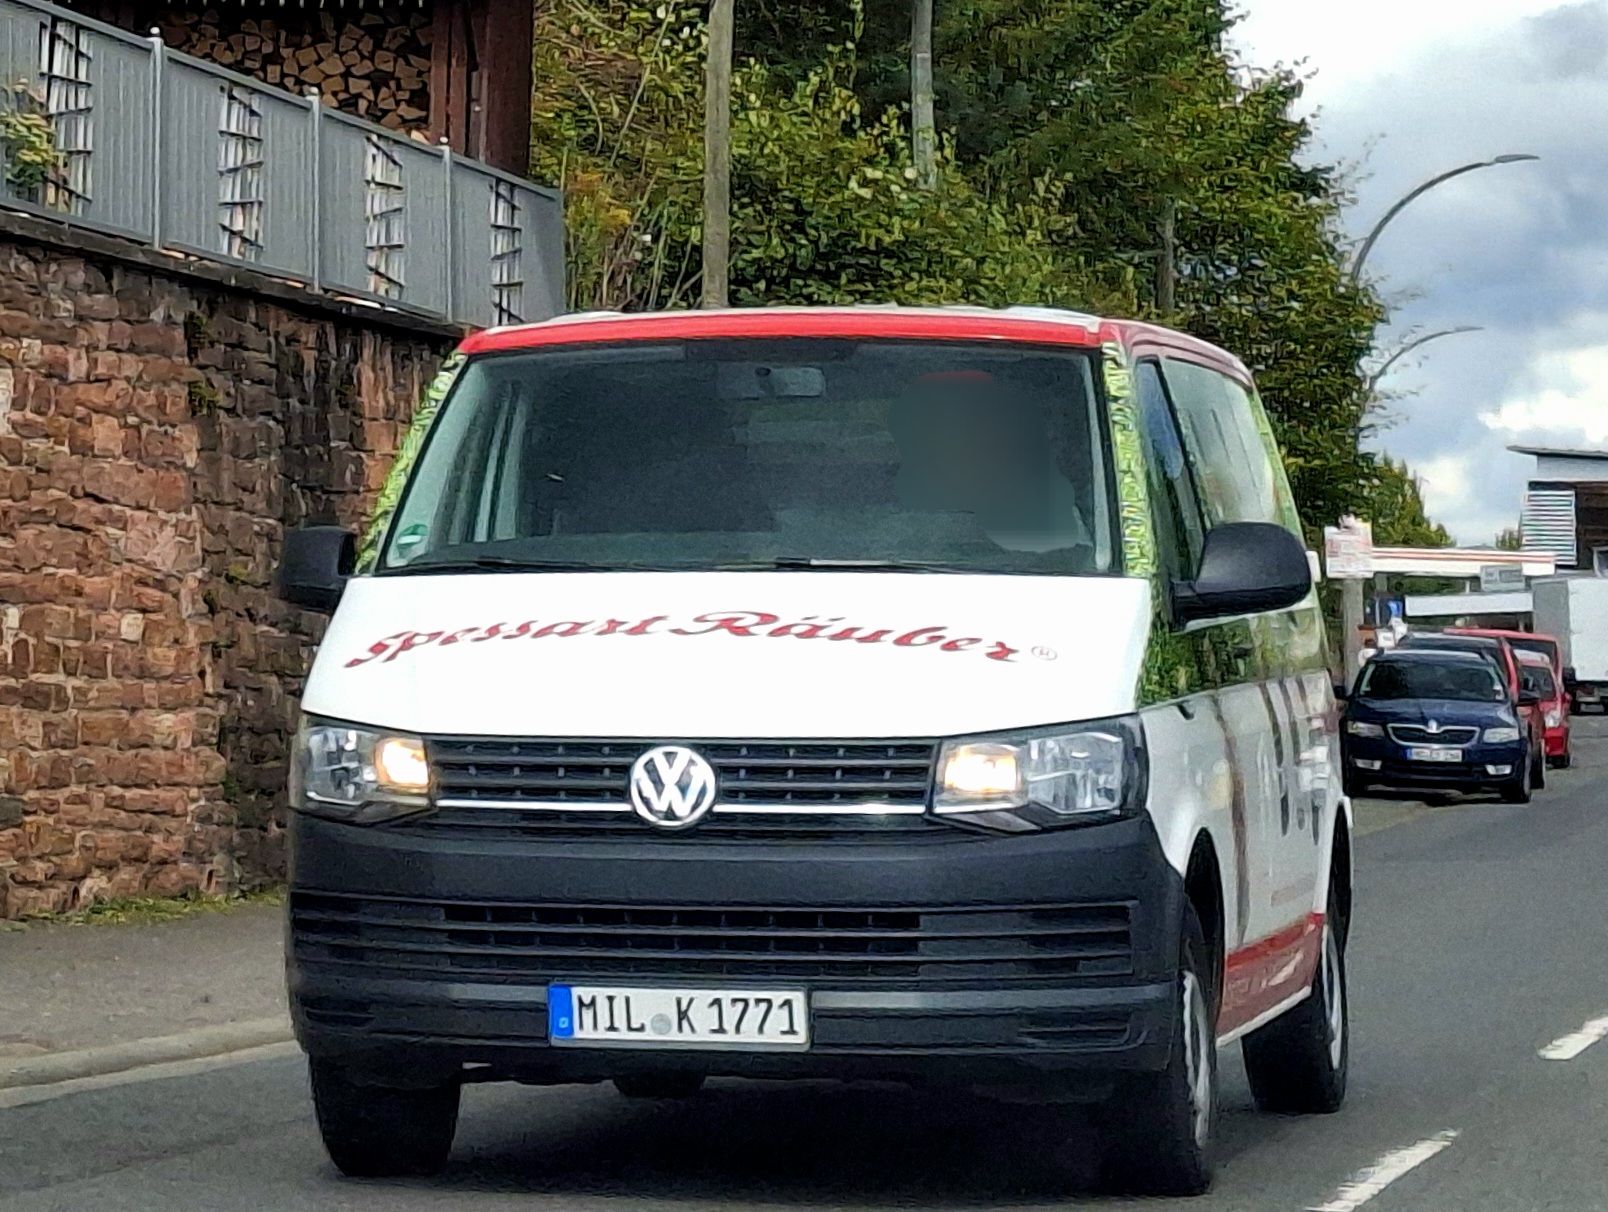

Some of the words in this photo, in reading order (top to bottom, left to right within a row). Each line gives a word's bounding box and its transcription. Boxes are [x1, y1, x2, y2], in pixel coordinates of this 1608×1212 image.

[345, 614, 669, 668] Spessart
[668, 610, 1020, 663] Räuber
[577, 994, 646, 1033] MIL
